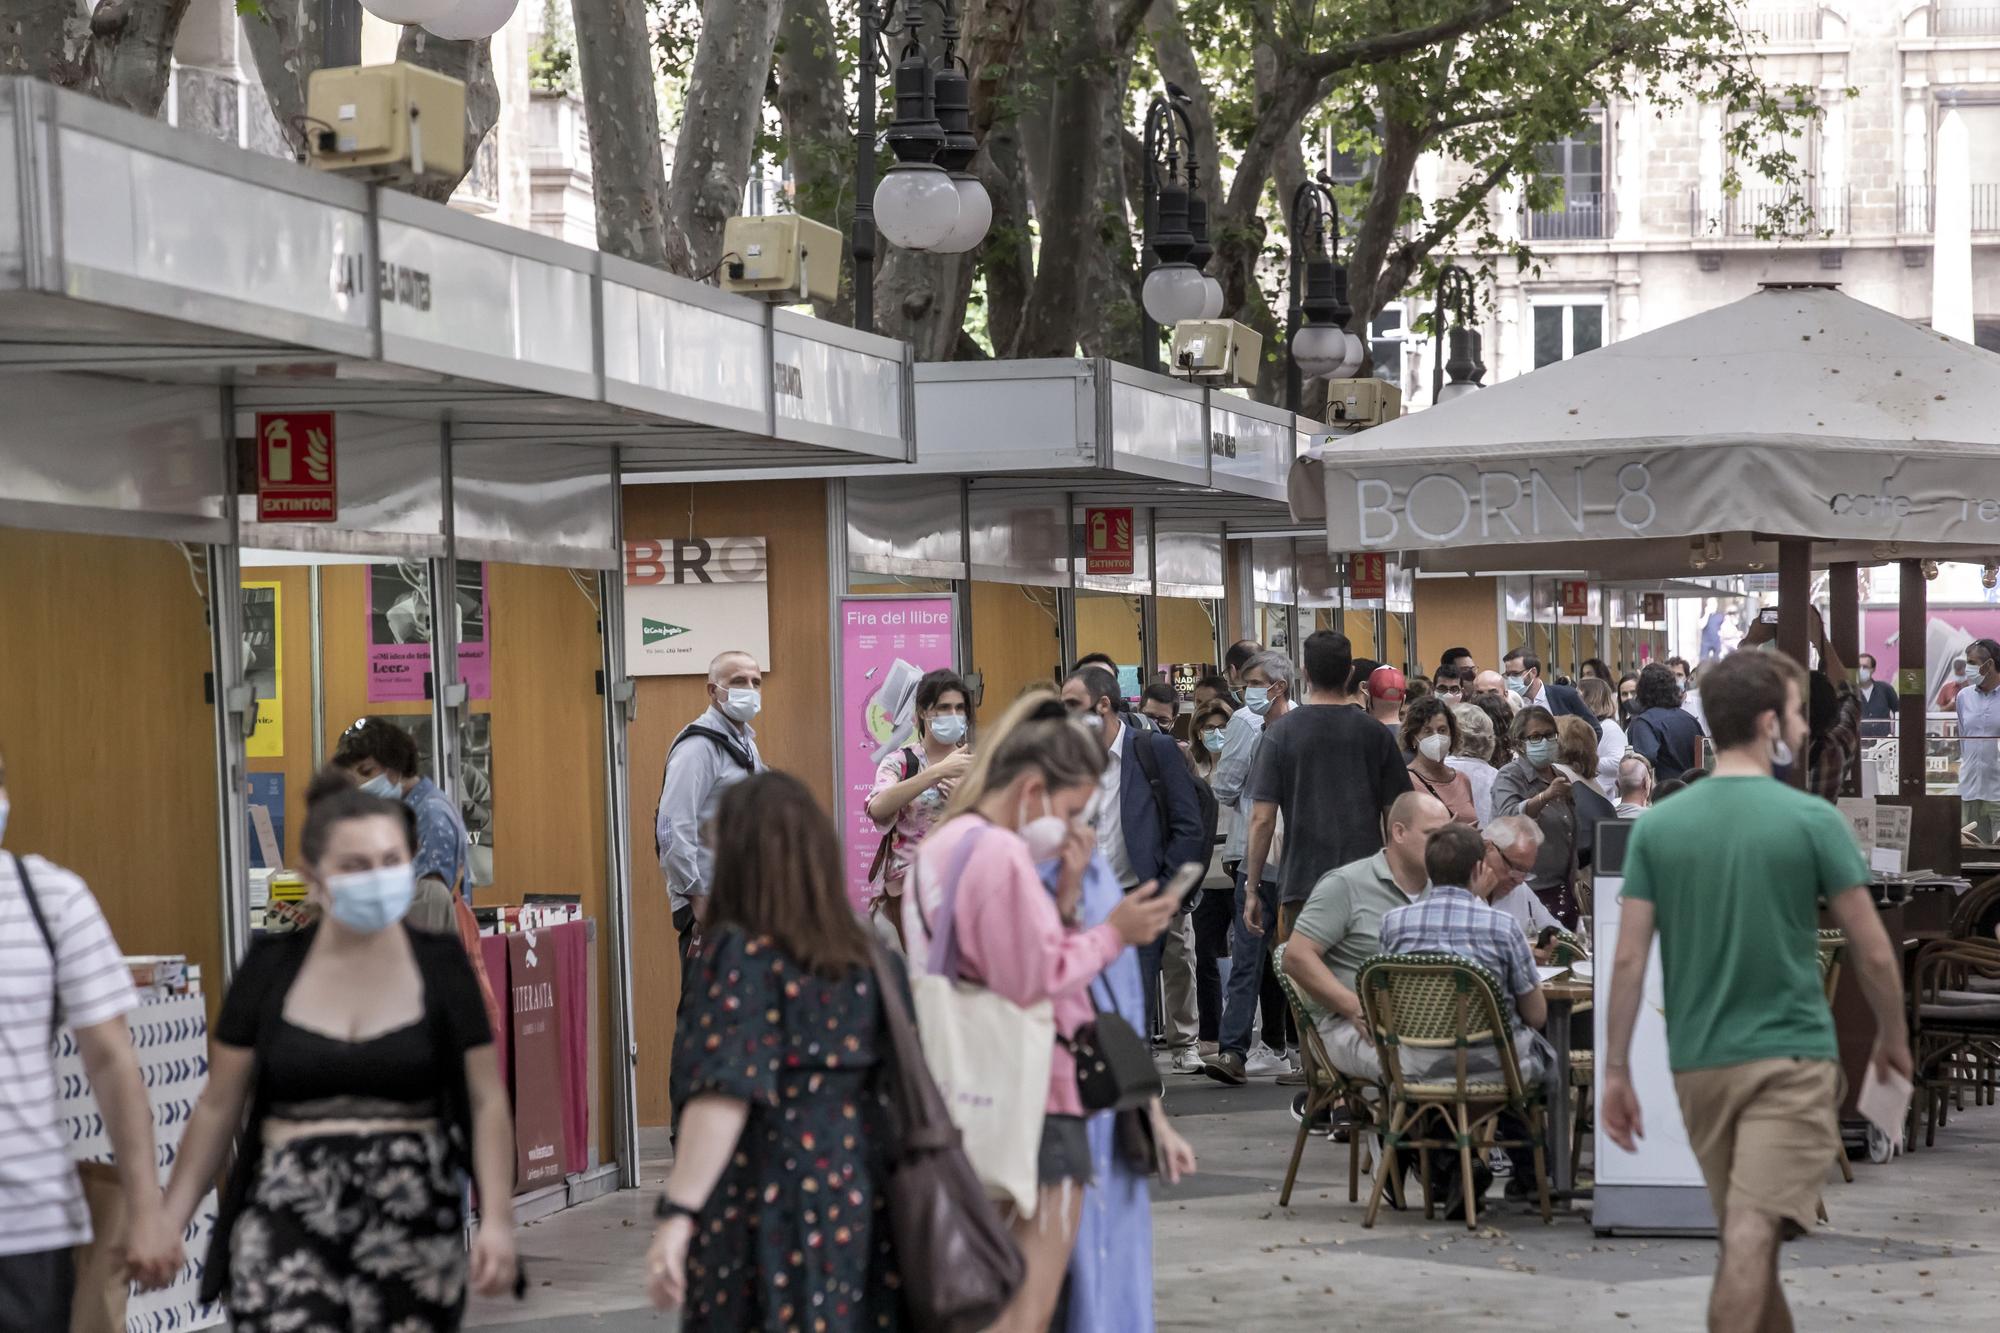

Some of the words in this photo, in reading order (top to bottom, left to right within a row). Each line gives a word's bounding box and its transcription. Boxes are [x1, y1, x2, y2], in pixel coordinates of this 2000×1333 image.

[263, 497, 331, 512] EXTINTOR
[1089, 559, 1131, 568] EXTINTOR
[847, 611, 877, 625] Fira
[881, 611, 906, 625] del
[910, 610, 949, 624] llibre
